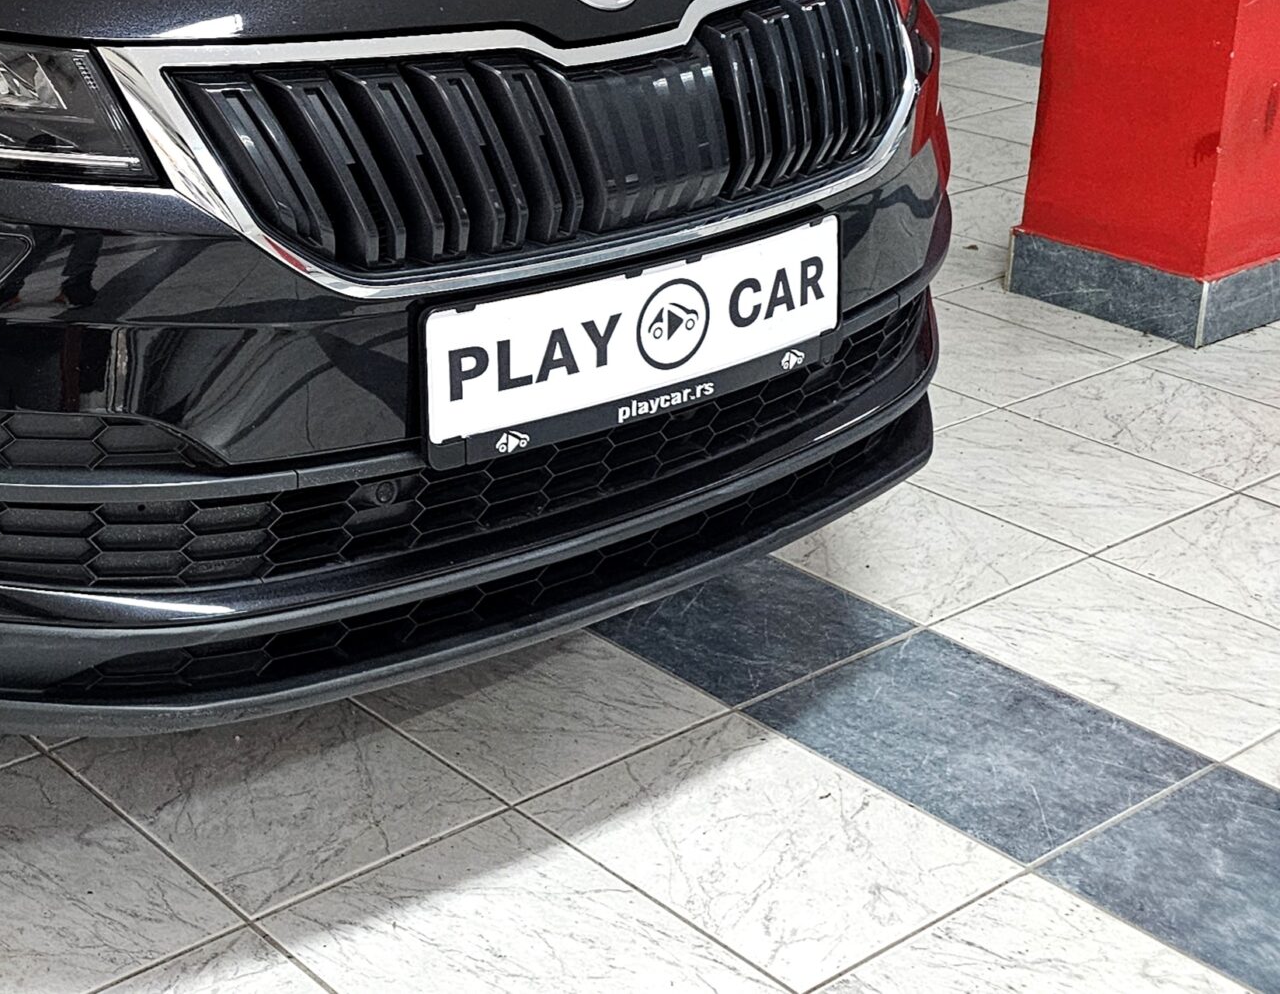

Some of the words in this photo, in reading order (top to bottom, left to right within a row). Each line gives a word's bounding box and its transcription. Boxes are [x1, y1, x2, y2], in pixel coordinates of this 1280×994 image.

[447, 312, 623, 402] PLAY
[727, 254, 826, 329] CAR
[617, 381, 715, 424] playcar.rs
